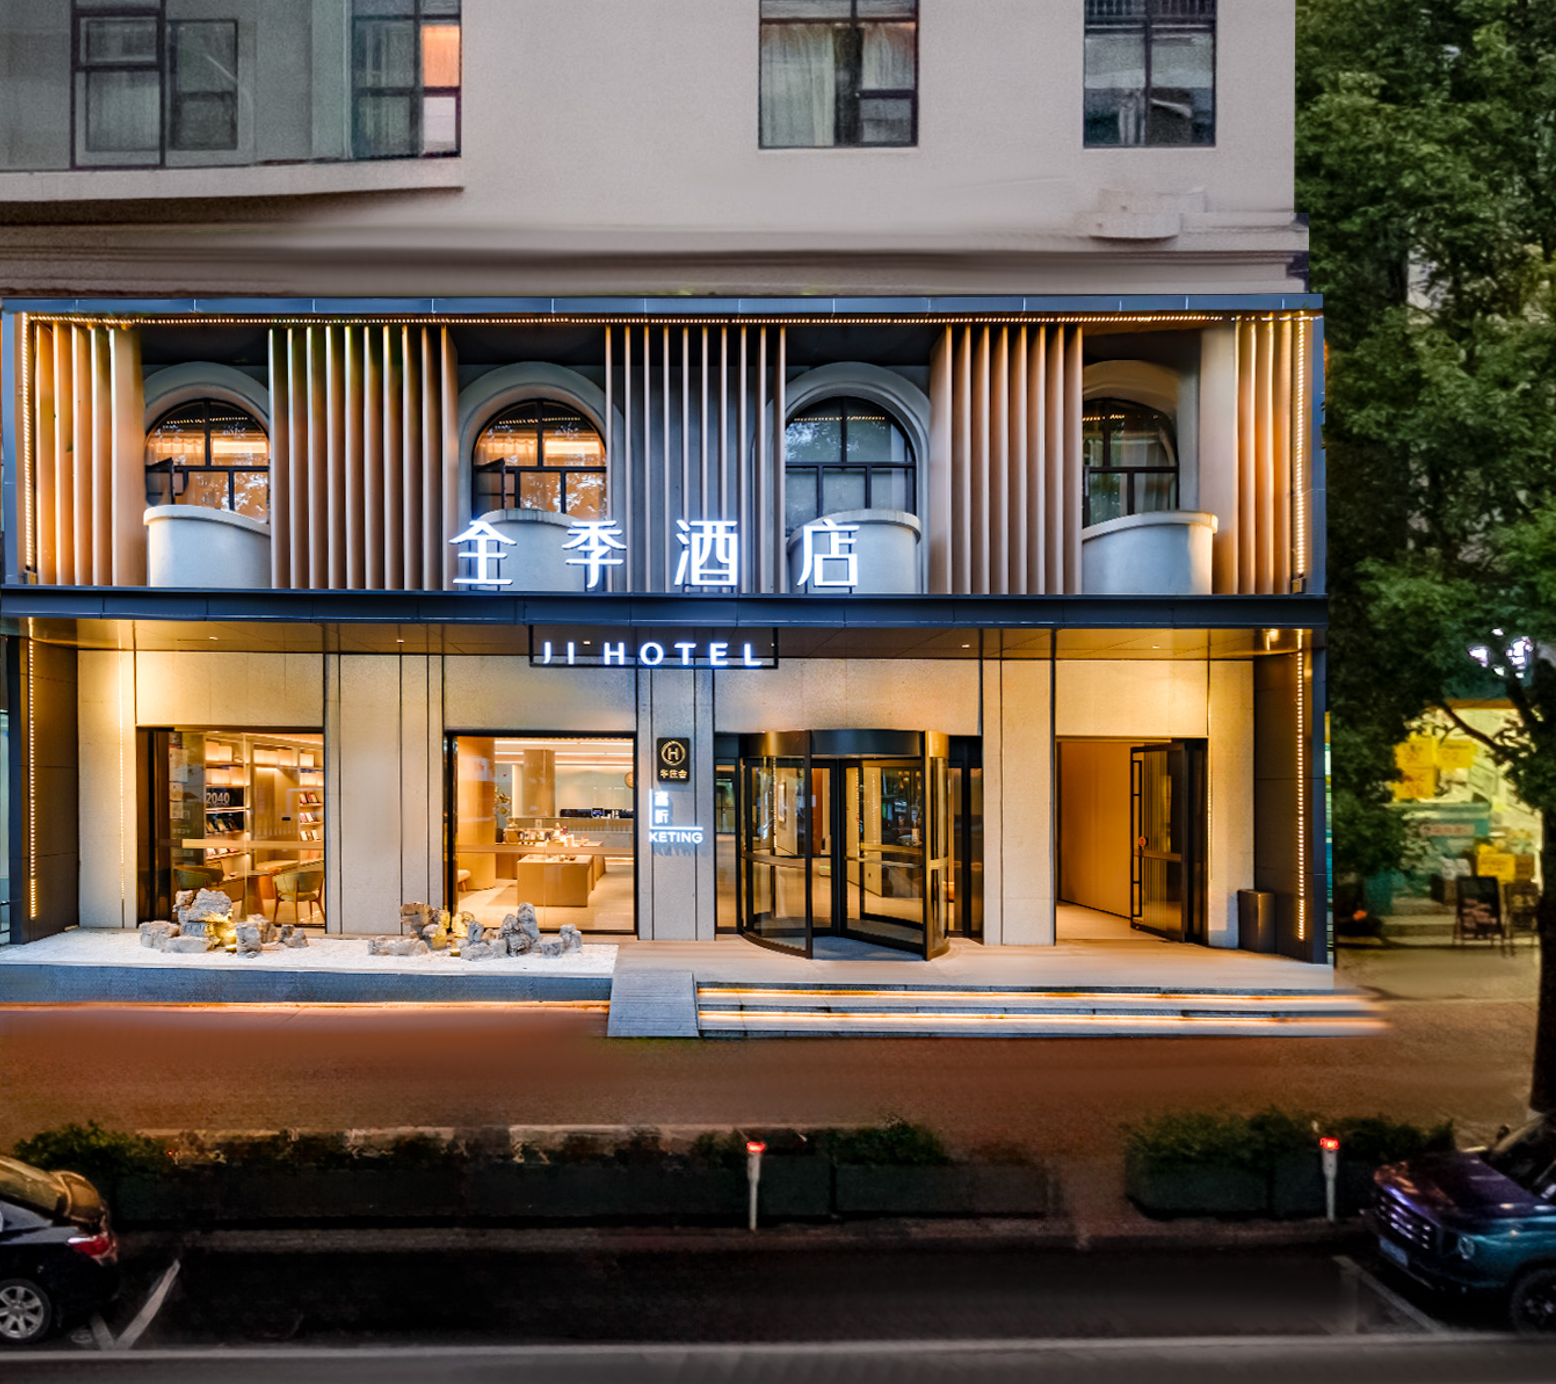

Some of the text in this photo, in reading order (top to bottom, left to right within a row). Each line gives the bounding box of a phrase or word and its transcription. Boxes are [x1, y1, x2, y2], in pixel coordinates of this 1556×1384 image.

[448, 518, 861, 590] 全季酒店
[542, 641, 763, 667] JI HOTEL
[648, 831, 704, 844] KETING
